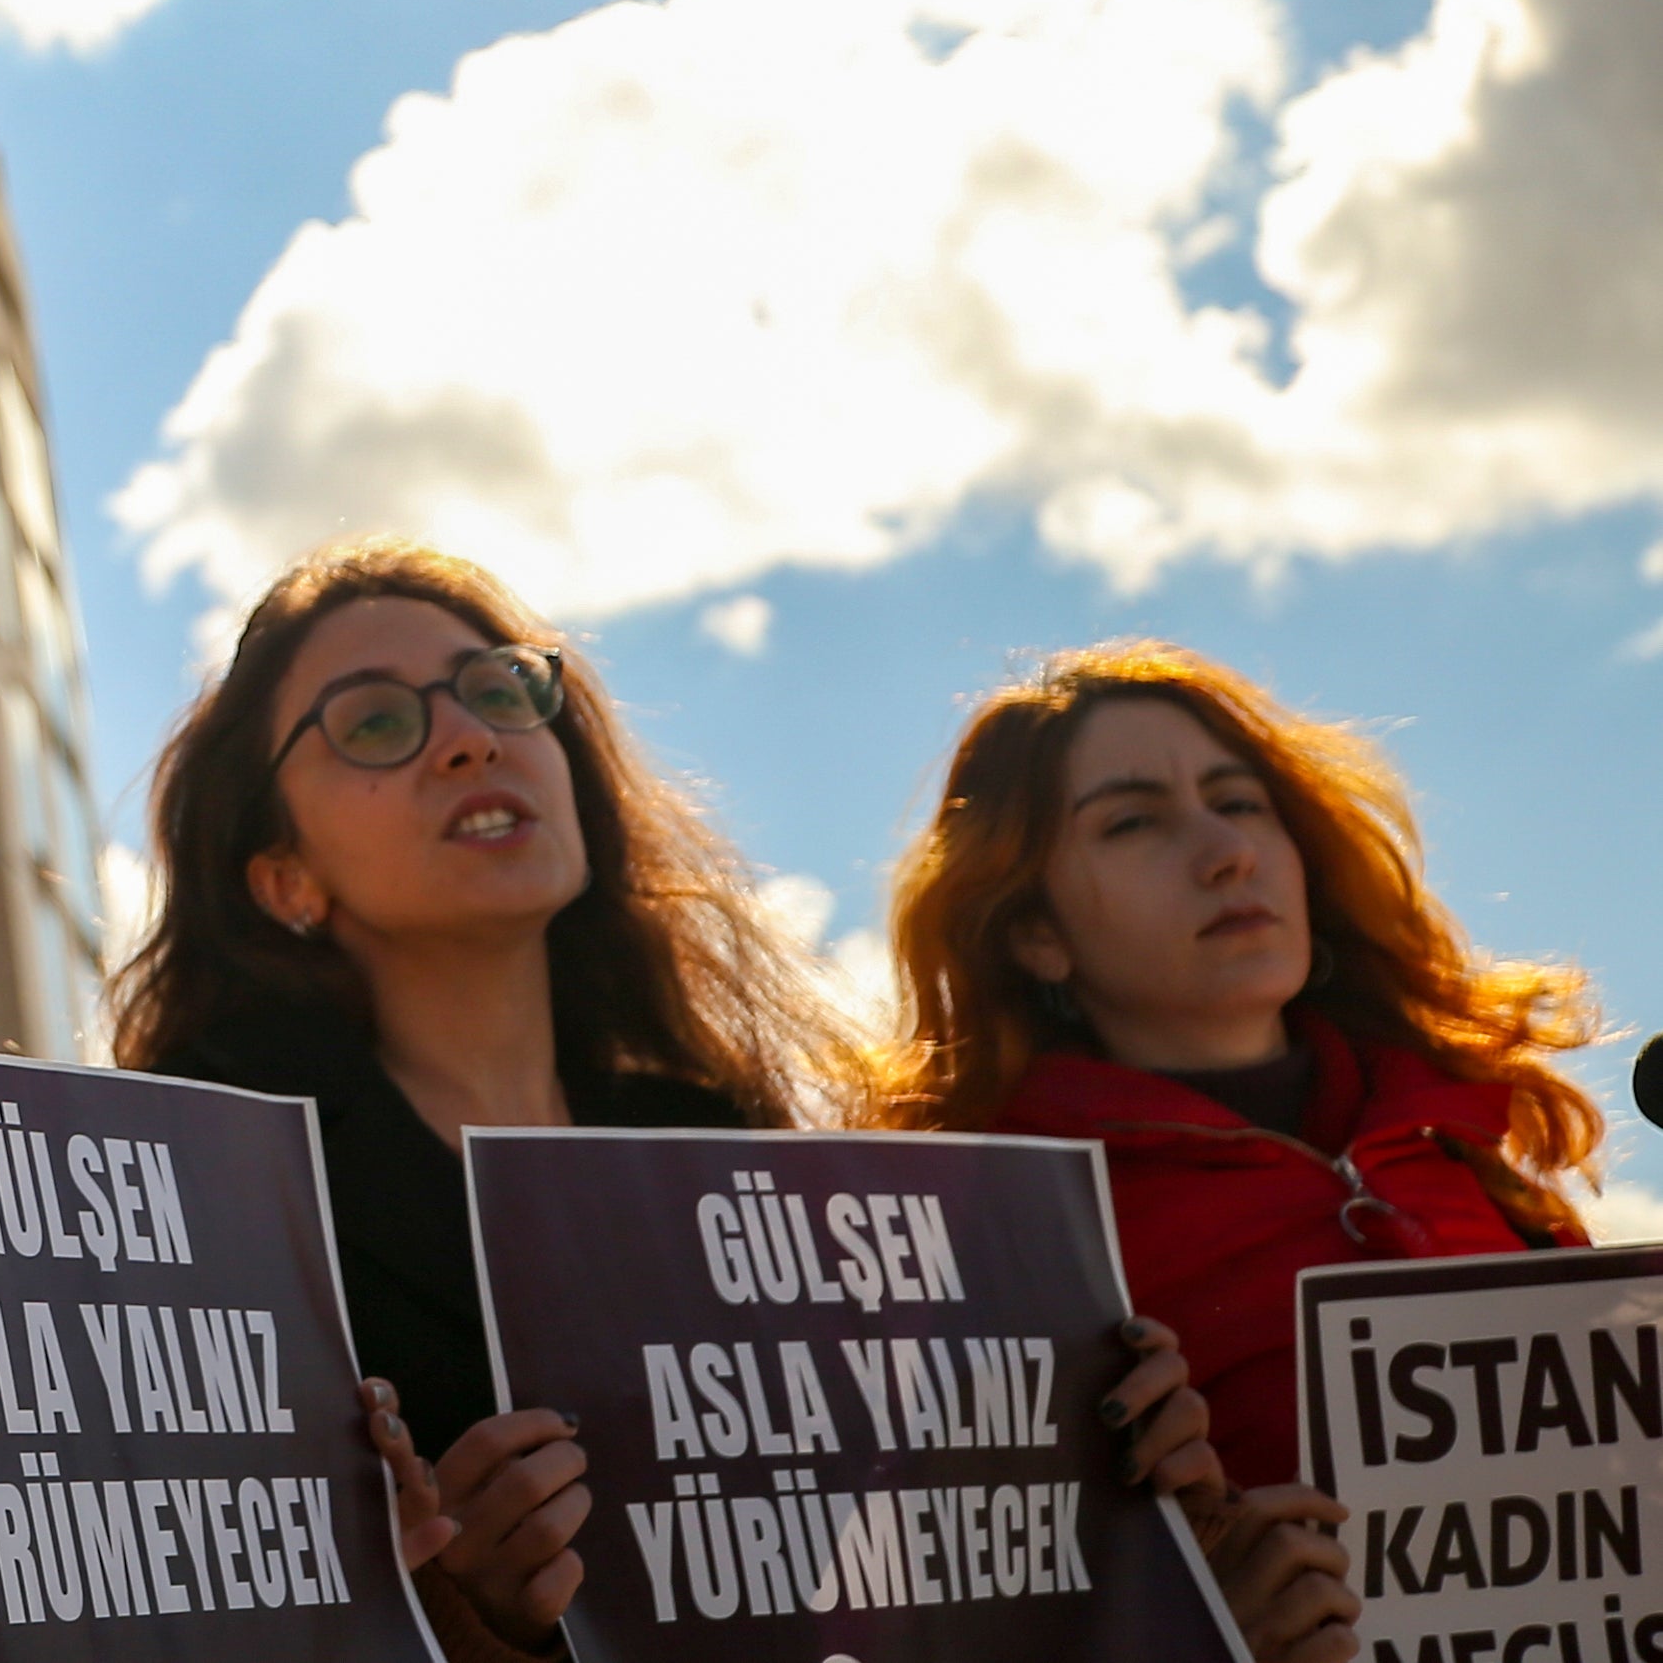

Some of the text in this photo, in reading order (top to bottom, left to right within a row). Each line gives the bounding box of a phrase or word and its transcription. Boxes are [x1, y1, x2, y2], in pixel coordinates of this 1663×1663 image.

[696, 1170, 967, 1314] GÜLŞEN
[78, 1303, 297, 1435] YALNIZ
[642, 1337, 1059, 1461] ASLA YALNIZ
[1349, 1317, 1663, 1467] İSTAN
[626, 1468, 1092, 1624] YÜRÜMEYECEK
[1364, 1485, 1643, 1599] KADIN
